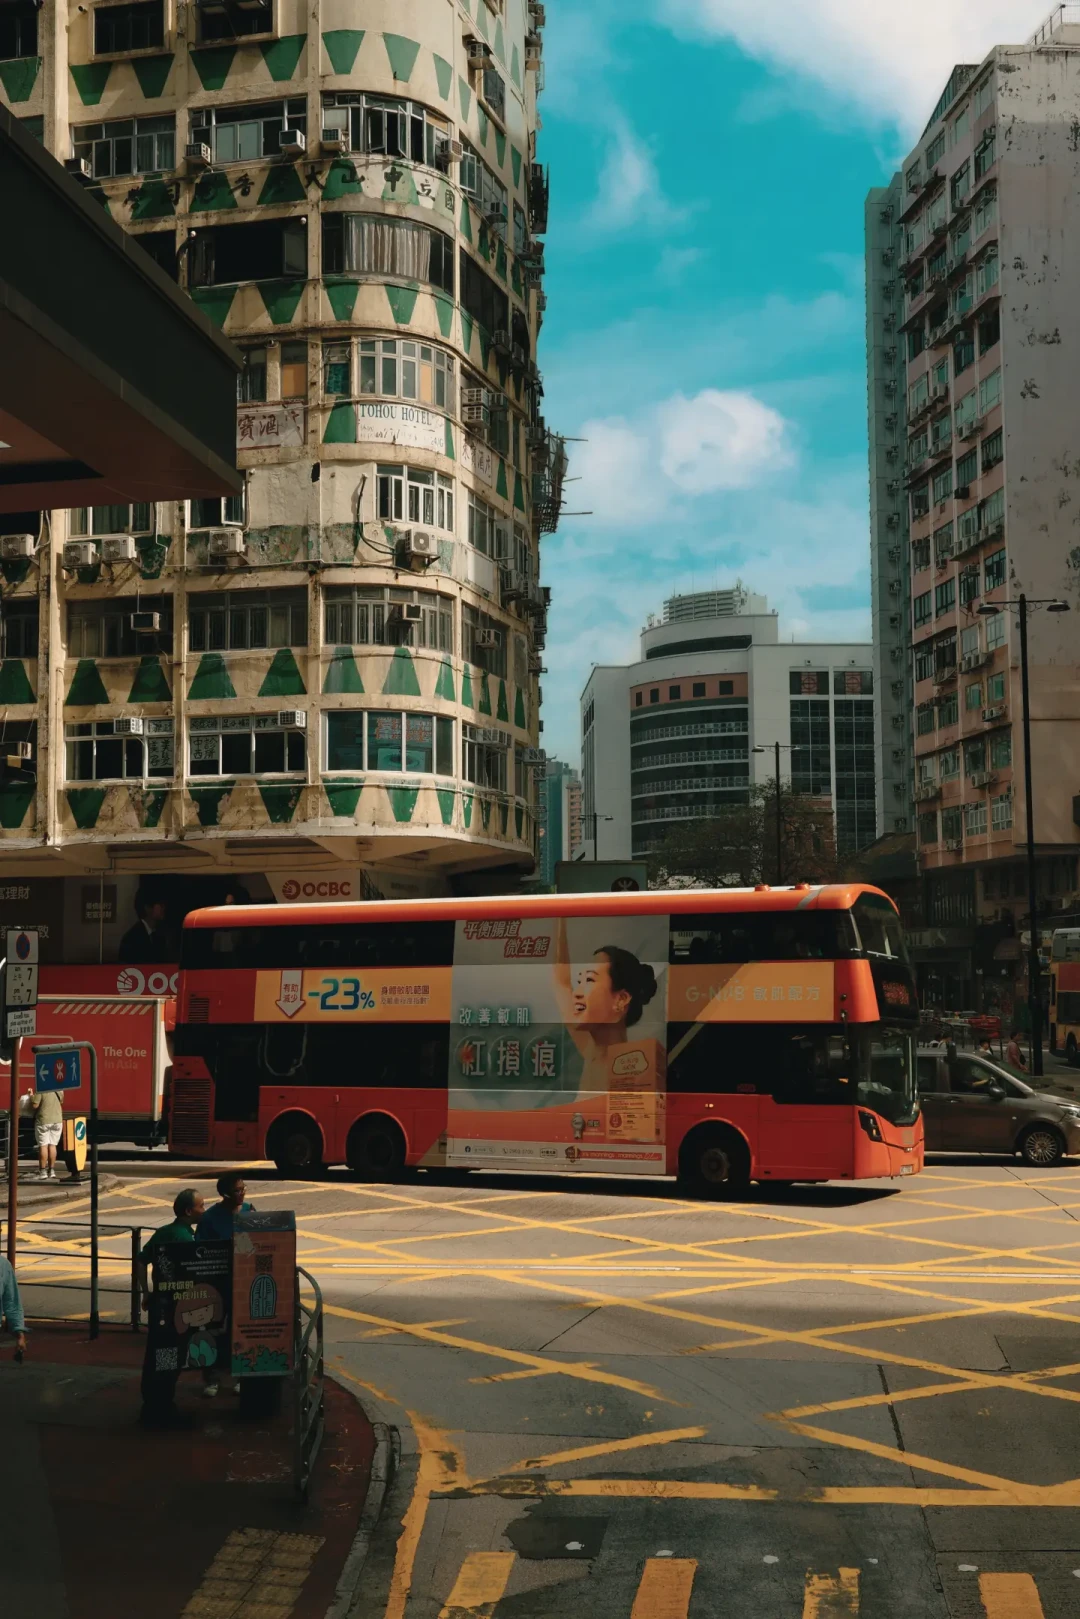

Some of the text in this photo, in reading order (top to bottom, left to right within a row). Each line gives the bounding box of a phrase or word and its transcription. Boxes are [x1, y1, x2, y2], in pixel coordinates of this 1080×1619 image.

[359, 403, 398, 419] TOHOU
[302, 881, 351, 897] OCBC
[464, 920, 521, 938] 平衡腸道
[504, 937, 549, 956] 微生態
[27, 967, 33, 980] 7
[26, 988, 32, 1002] 7
[282, 983, 299, 993] 有助
[308, 977, 375, 1010] -23%
[753, 985, 821, 1001] 敏肌配方
[282, 993, 299, 1003] 減少
[459, 1007, 530, 1027] 改善敏肌
[102, 1046, 147, 1057] The One
